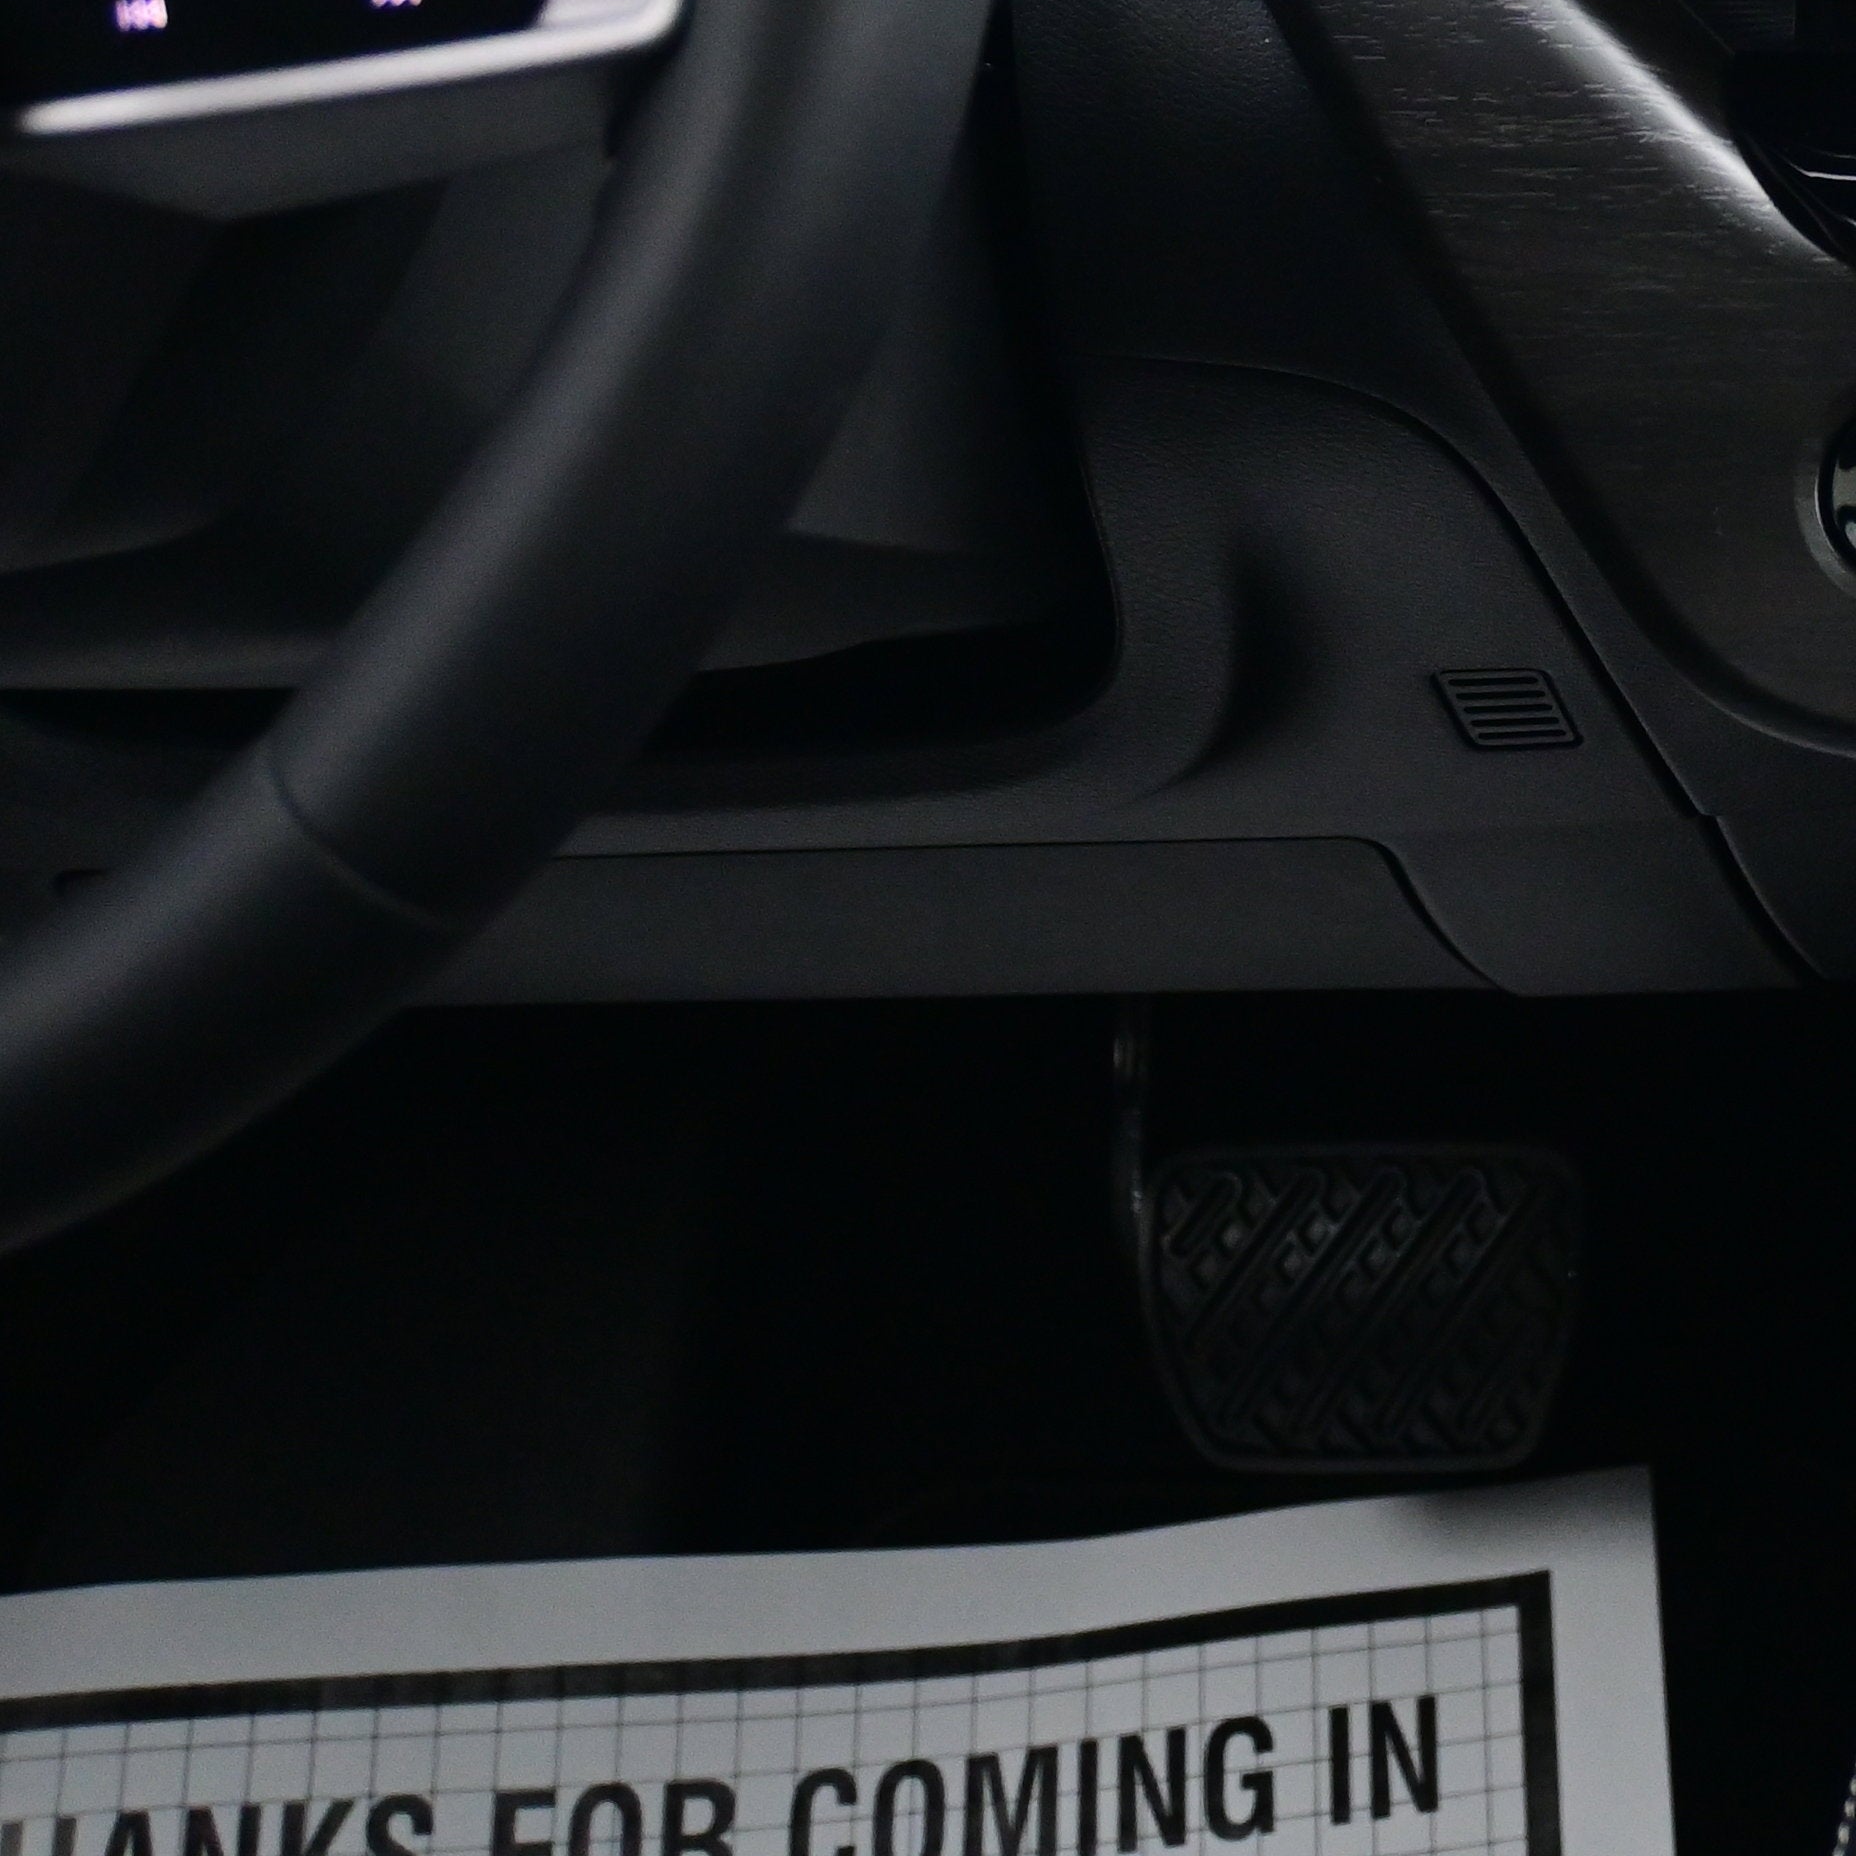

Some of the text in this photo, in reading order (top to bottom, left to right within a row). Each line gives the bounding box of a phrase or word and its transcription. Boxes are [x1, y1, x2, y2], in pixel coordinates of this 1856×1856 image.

[490, 1777, 738, 1856] FOR
[788, 1715, 1275, 1856] COMING
[1328, 1693, 1440, 1825] IN
